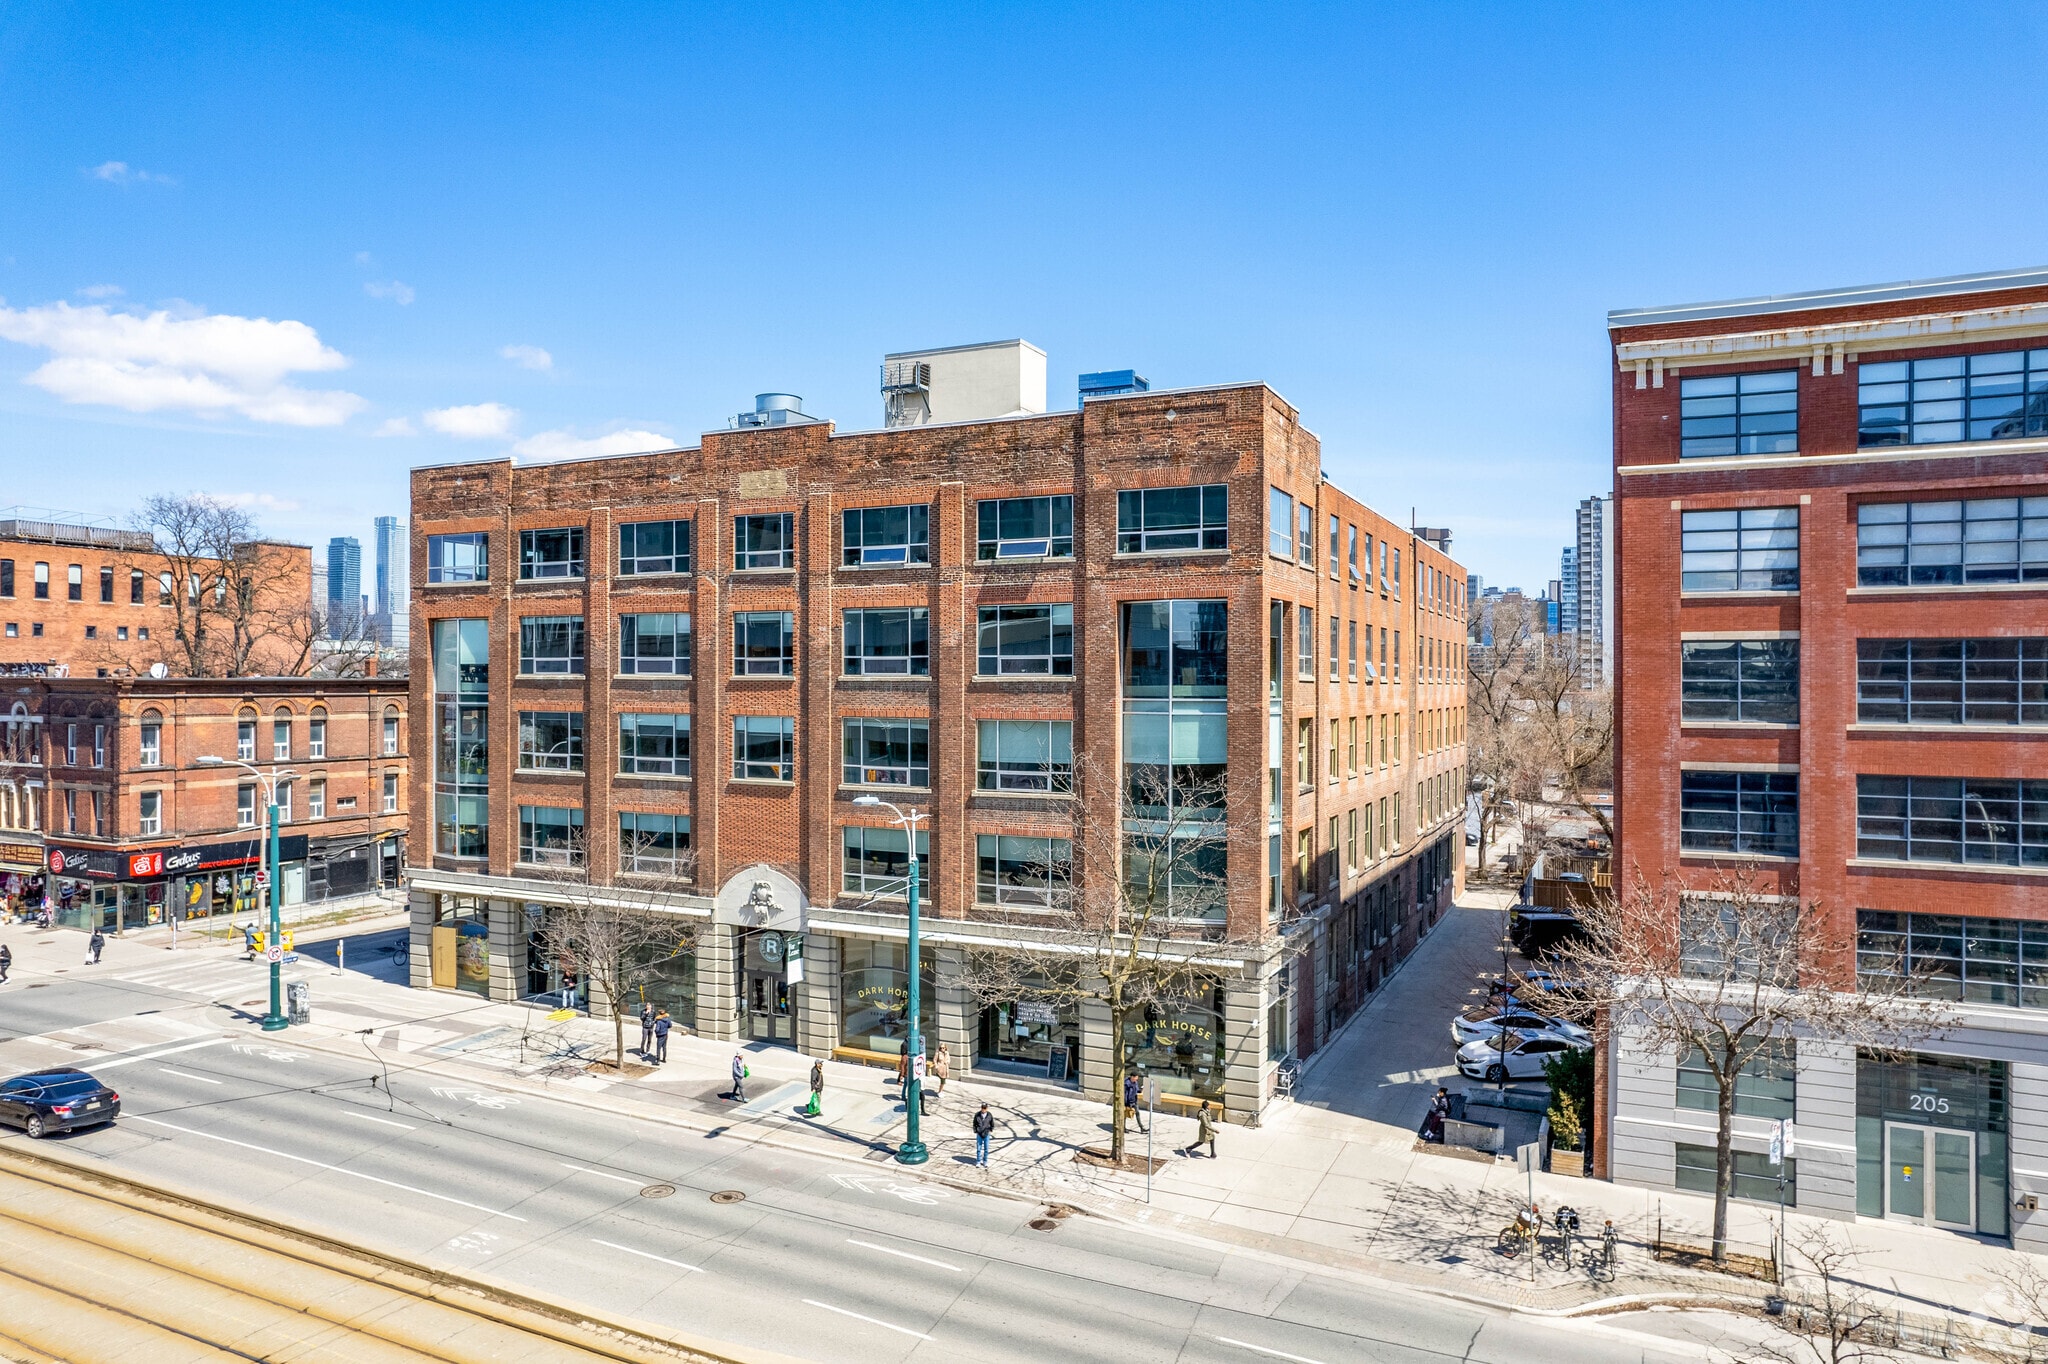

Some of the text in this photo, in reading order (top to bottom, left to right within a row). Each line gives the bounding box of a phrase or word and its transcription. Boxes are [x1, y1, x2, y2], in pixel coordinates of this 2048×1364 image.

[243, 856, 260, 864] HOUS
[766, 939, 777, 954] R
[858, 986, 908, 998] DARK HOR
[1135, 1020, 1212, 1041] DARK HORSE
[1910, 1094, 1949, 1113] 205
